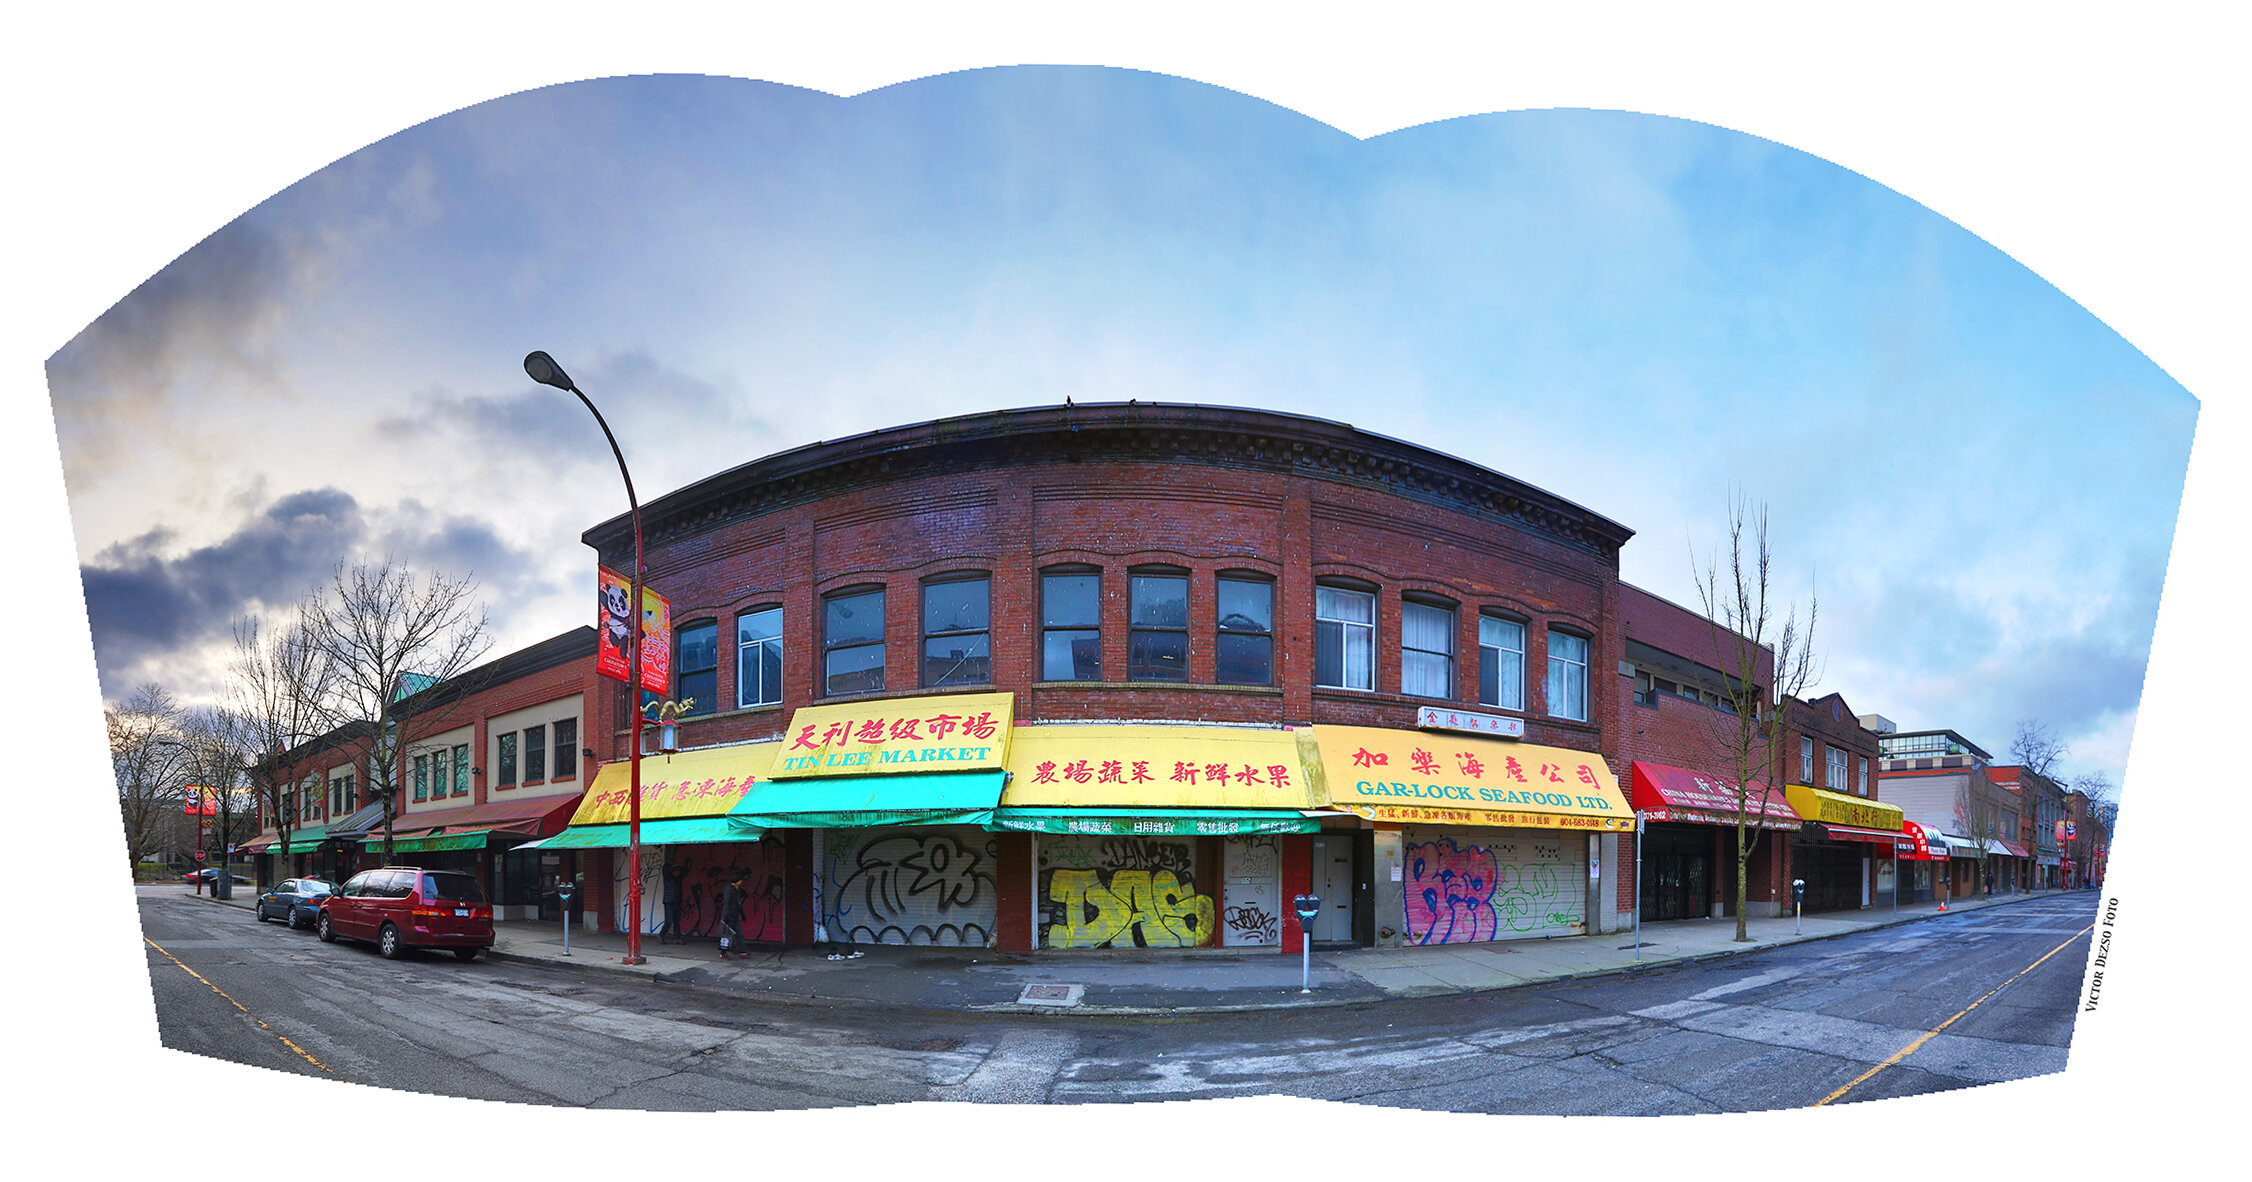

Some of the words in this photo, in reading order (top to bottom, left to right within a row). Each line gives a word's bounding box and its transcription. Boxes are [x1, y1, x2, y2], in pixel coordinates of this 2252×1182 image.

[784, 755, 823, 771] TIN
[825, 752, 873, 767] LEE
[879, 747, 991, 764] MARKET
[1031, 760, 1156, 785] 農場蔬菜
[1169, 761, 1291, 788] 新鮮水果
[1356, 781, 1475, 801] GAR-LOCK
[1480, 788, 1573, 808] SEAFOOD
[1575, 795, 1613, 811] LTD.
[1003, 820, 1046, 831] 新鮮水果
[1134, 822, 1175, 834] 日用雜貨
